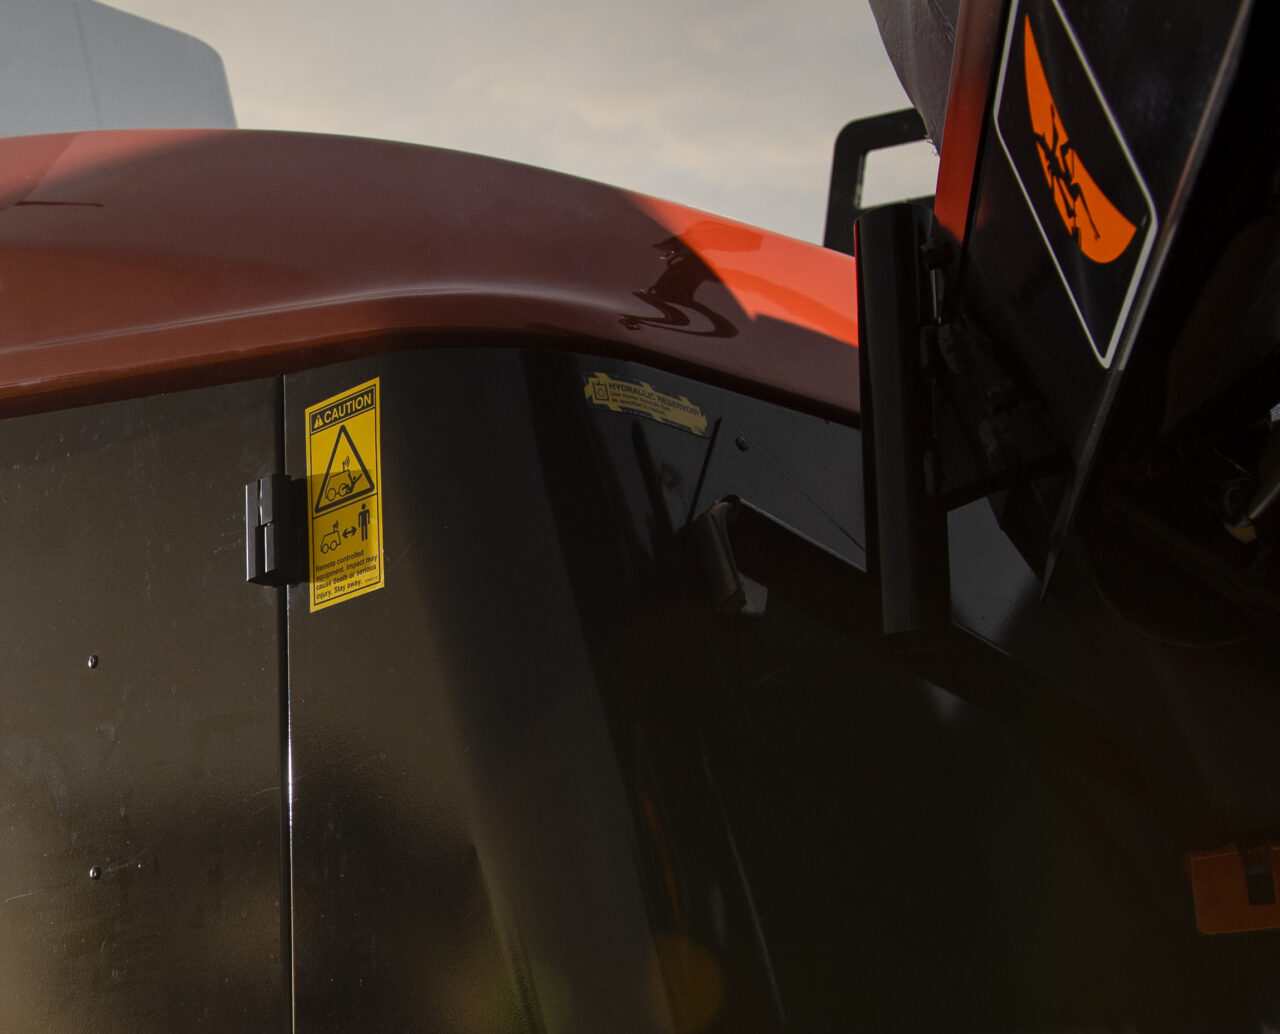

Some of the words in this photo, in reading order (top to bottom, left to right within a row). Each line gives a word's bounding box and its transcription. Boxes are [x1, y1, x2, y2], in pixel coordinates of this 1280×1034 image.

[323, 392, 372, 424] CAUTION
[337, 550, 364, 565] controlled
[366, 554, 378, 563] may
[316, 580, 331, 591] cause
[333, 574, 348, 585] death
[356, 564, 377, 576] serious
[333, 584, 347, 594] Stay
